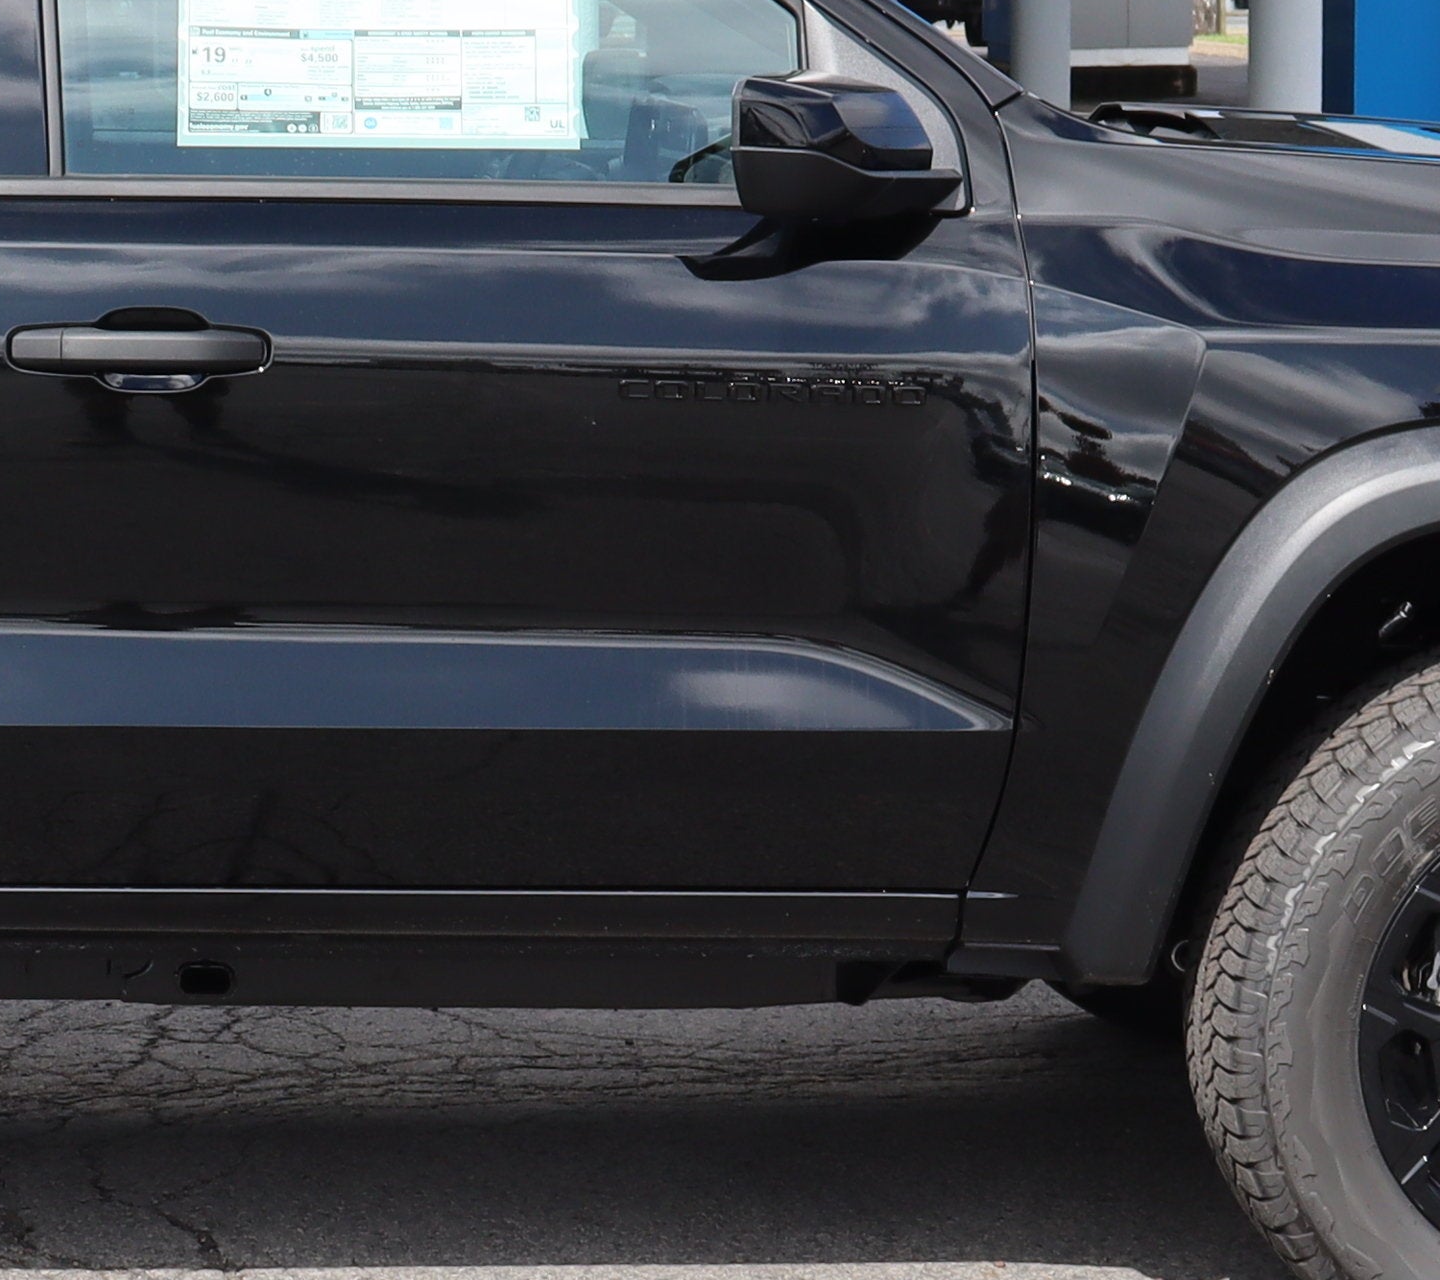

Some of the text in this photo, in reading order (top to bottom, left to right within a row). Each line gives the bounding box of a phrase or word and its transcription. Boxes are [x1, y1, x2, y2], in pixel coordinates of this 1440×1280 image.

[202, 46, 226, 63] 19
[300, 53, 339, 63] $4,500
[617, 378, 927, 407] COLORADO
